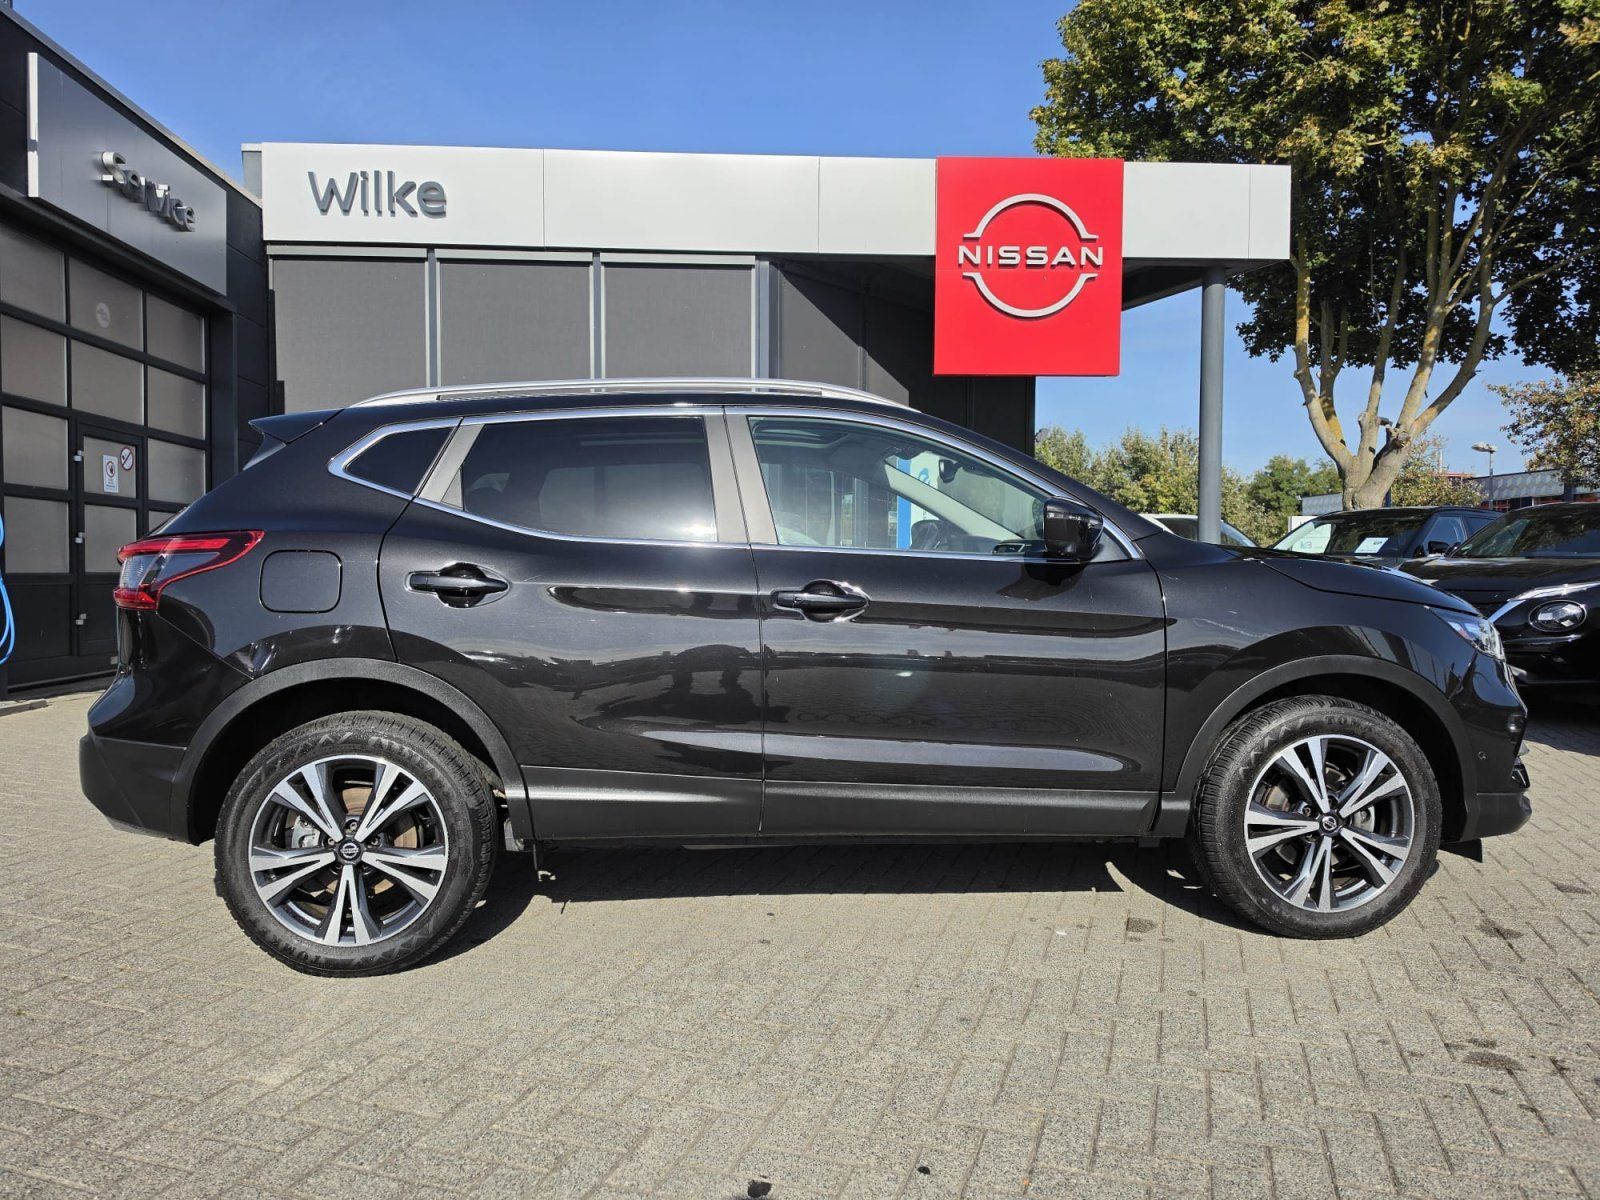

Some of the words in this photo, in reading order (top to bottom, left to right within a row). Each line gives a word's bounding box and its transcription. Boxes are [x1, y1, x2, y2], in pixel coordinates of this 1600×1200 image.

[102, 151, 195, 232] Service
[308, 170, 447, 218] Wilke
[958, 245, 1103, 268] NISSAN
